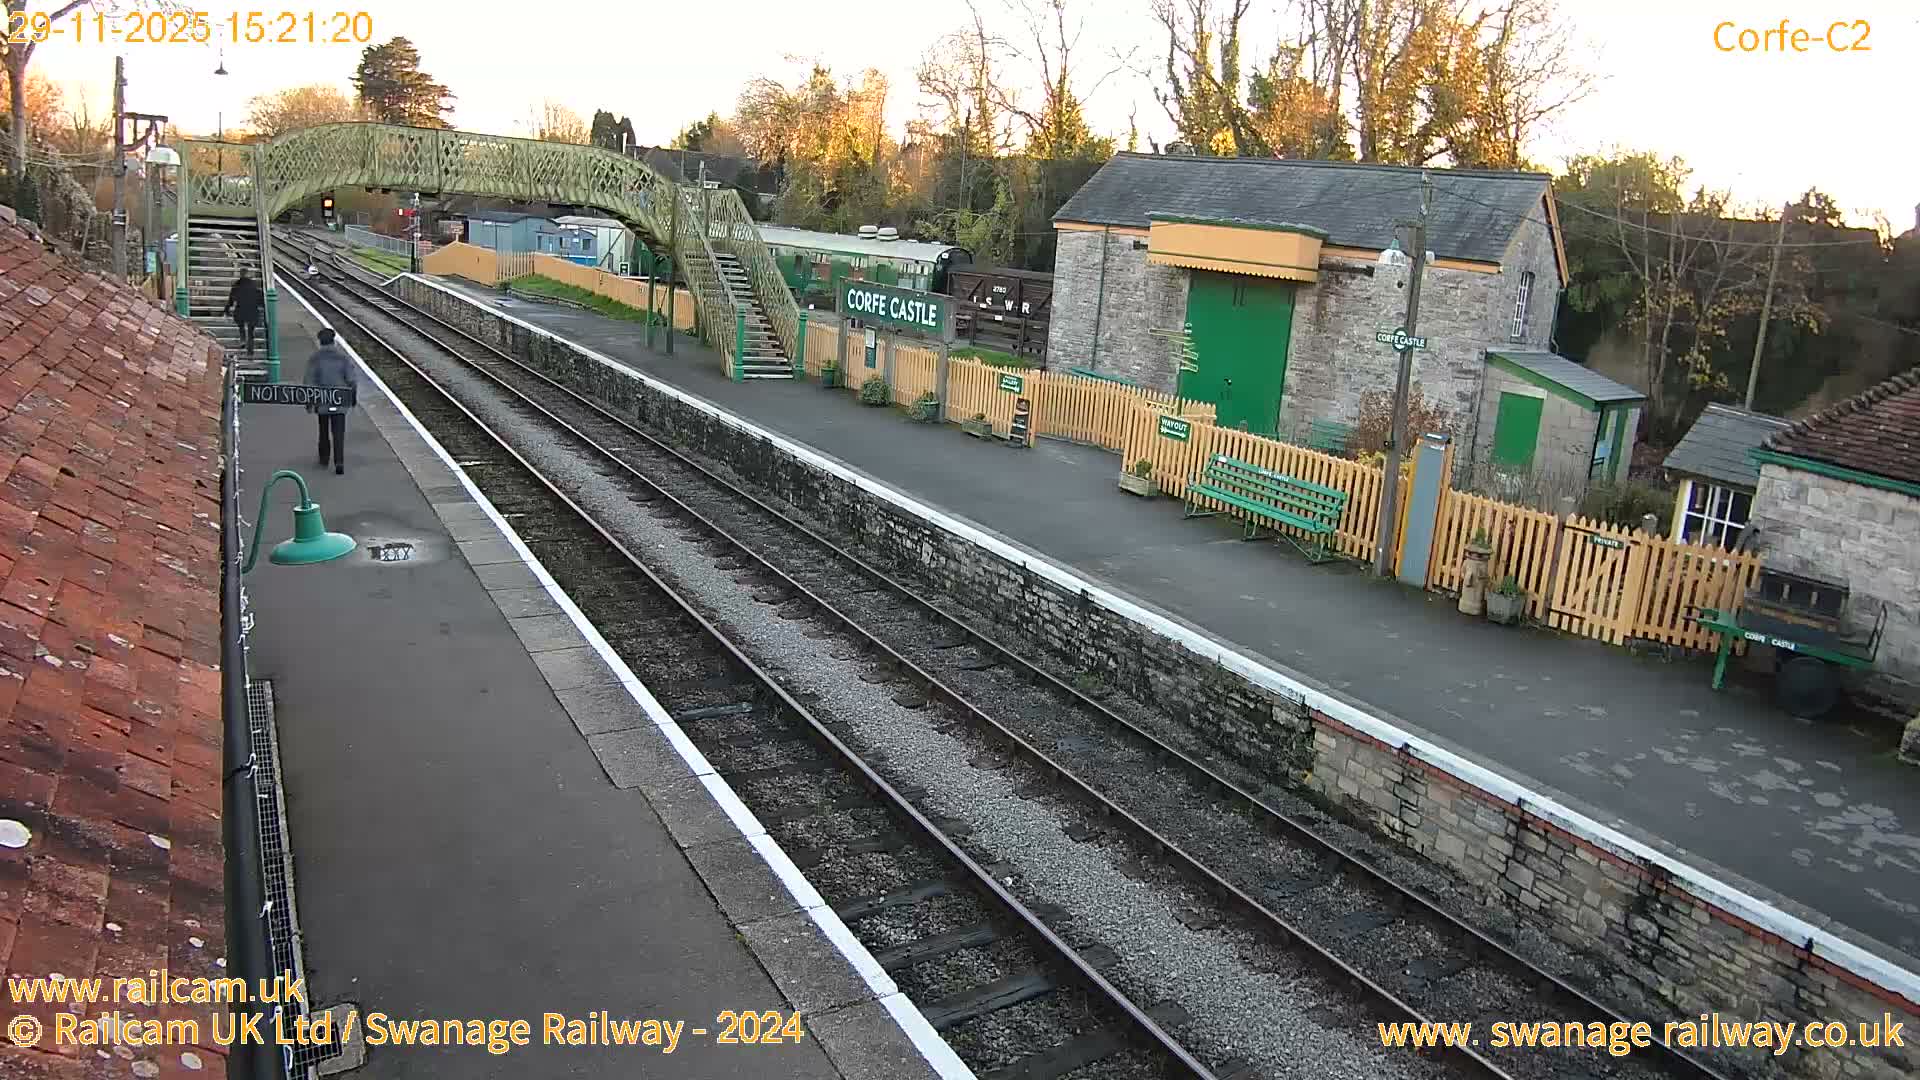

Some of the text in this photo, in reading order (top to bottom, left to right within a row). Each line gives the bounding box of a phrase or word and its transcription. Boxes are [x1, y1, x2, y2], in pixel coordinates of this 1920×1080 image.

[847, 288, 937, 327] CORFE CASTLE
[1005, 300, 1014, 311] W
[1022, 302, 1030, 314] R
[1377, 333, 1425, 348] CORFE CASTLE
[251, 385, 342, 405] NOT STOPPING
